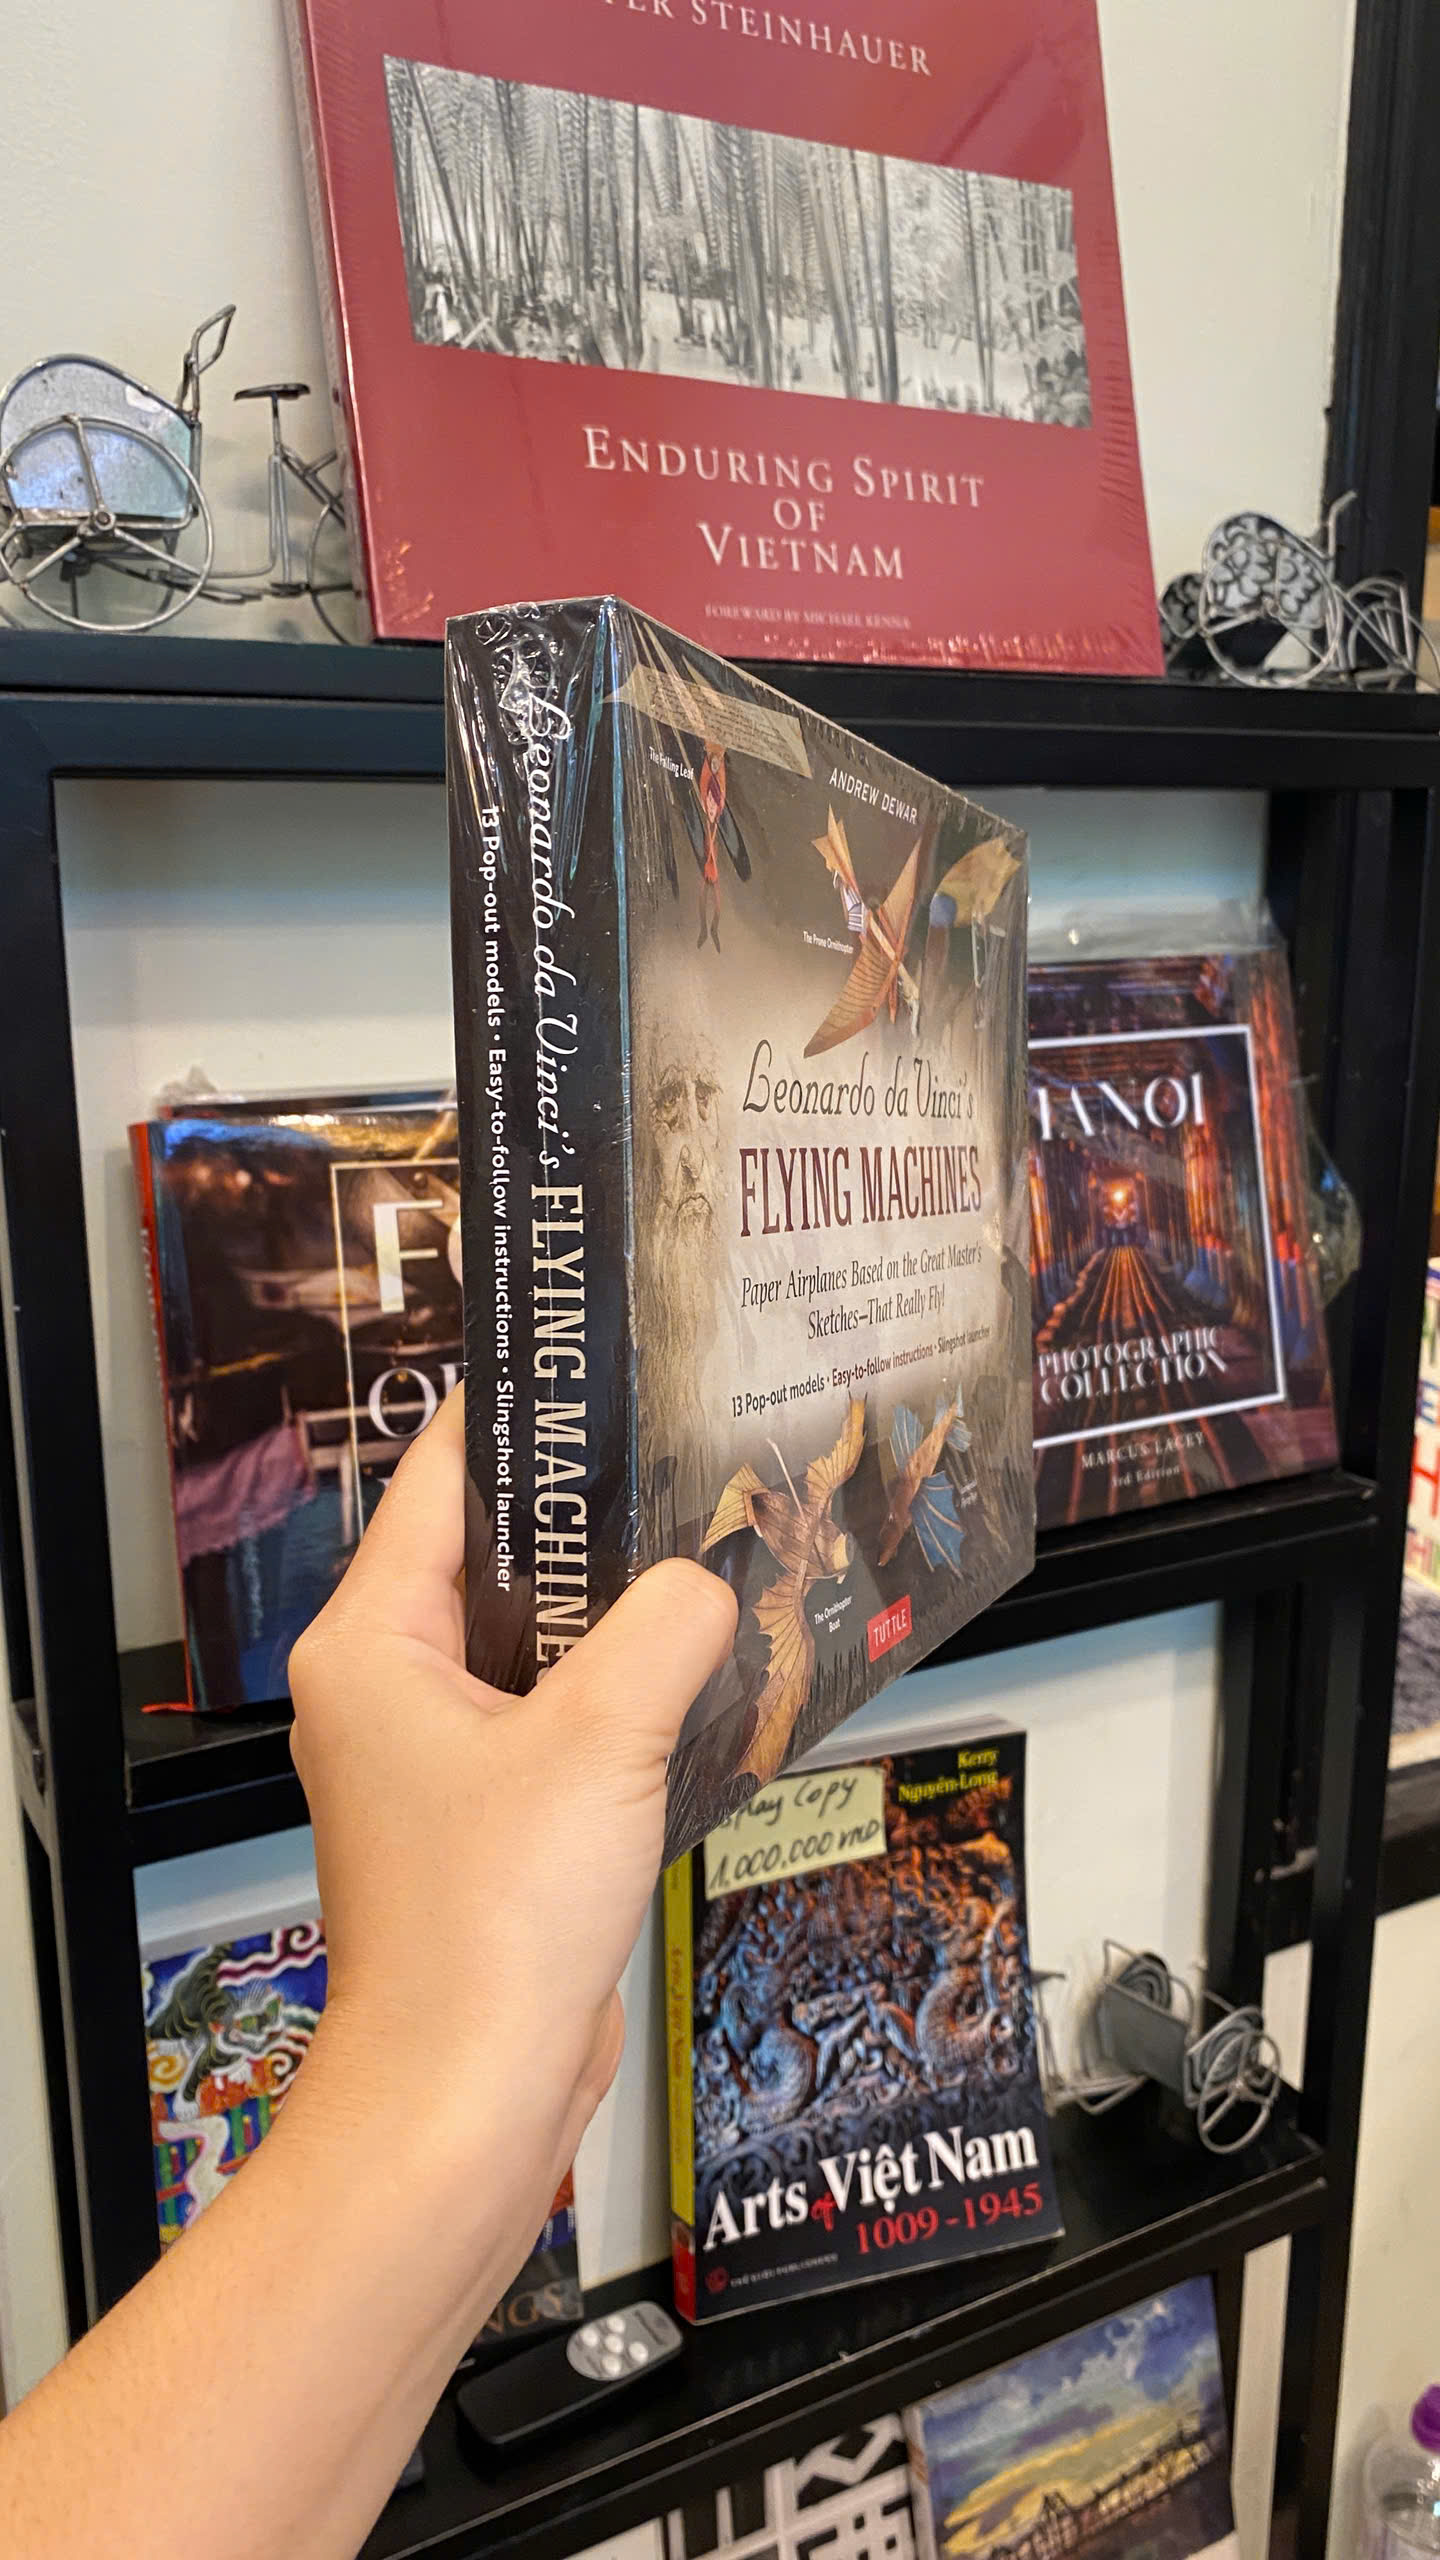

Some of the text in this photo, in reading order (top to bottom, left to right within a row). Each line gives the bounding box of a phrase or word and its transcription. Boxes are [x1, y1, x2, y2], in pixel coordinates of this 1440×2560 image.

[691, 0, 932, 76] STEINHAUER
[583, 425, 984, 508] ENDURING SPIRIT
[773, 496, 827, 532] OF
[698, 522, 904, 580] VIETNAM
[829, 768, 918, 825] ANDREW DEWAR
[742, 1039, 974, 1120] Leonardo da Vinci's
[479, 803, 514, 1592] 13 Pop-out models Easy-to-follow instructions Slingshot launcher
[529, 692, 588, 1683] Leonardo da Vinci's FLYING MACHINE
[739, 1145, 982, 1238] FLYING MACHINES
[741, 1240, 982, 1313] Paper Airplanes Based on the Great Master's
[896, 1287, 926, 1320] Really
[928, 1282, 946, 1315] Fly!
[732, 1396, 743, 1418] 13
[745, 1384, 788, 1415] Pop-out
[790, 1373, 825, 1399] models
[832, 1354, 892, 1388] Easy-to-follow
[892, 1343, 934, 1369] instructions
[937, 1333, 966, 1355] Slingshot
[1039, 1325, 1220, 1378] PHOTOGRAPHIC
[1041, 1350, 1228, 1405] COLLECTION
[1081, 1431, 1205, 1470] MARCUS LACEY
[814, 1612, 824, 1625] The
[829, 1618, 840, 1632] Boat
[873, 1608, 907, 1648] TUTTLE
[794, 1778, 858, 1819] Copy
[703, 2176, 809, 2251] Arts
[818, 2142, 923, 2214] Việt
[923, 2126, 1040, 2184] Nam
